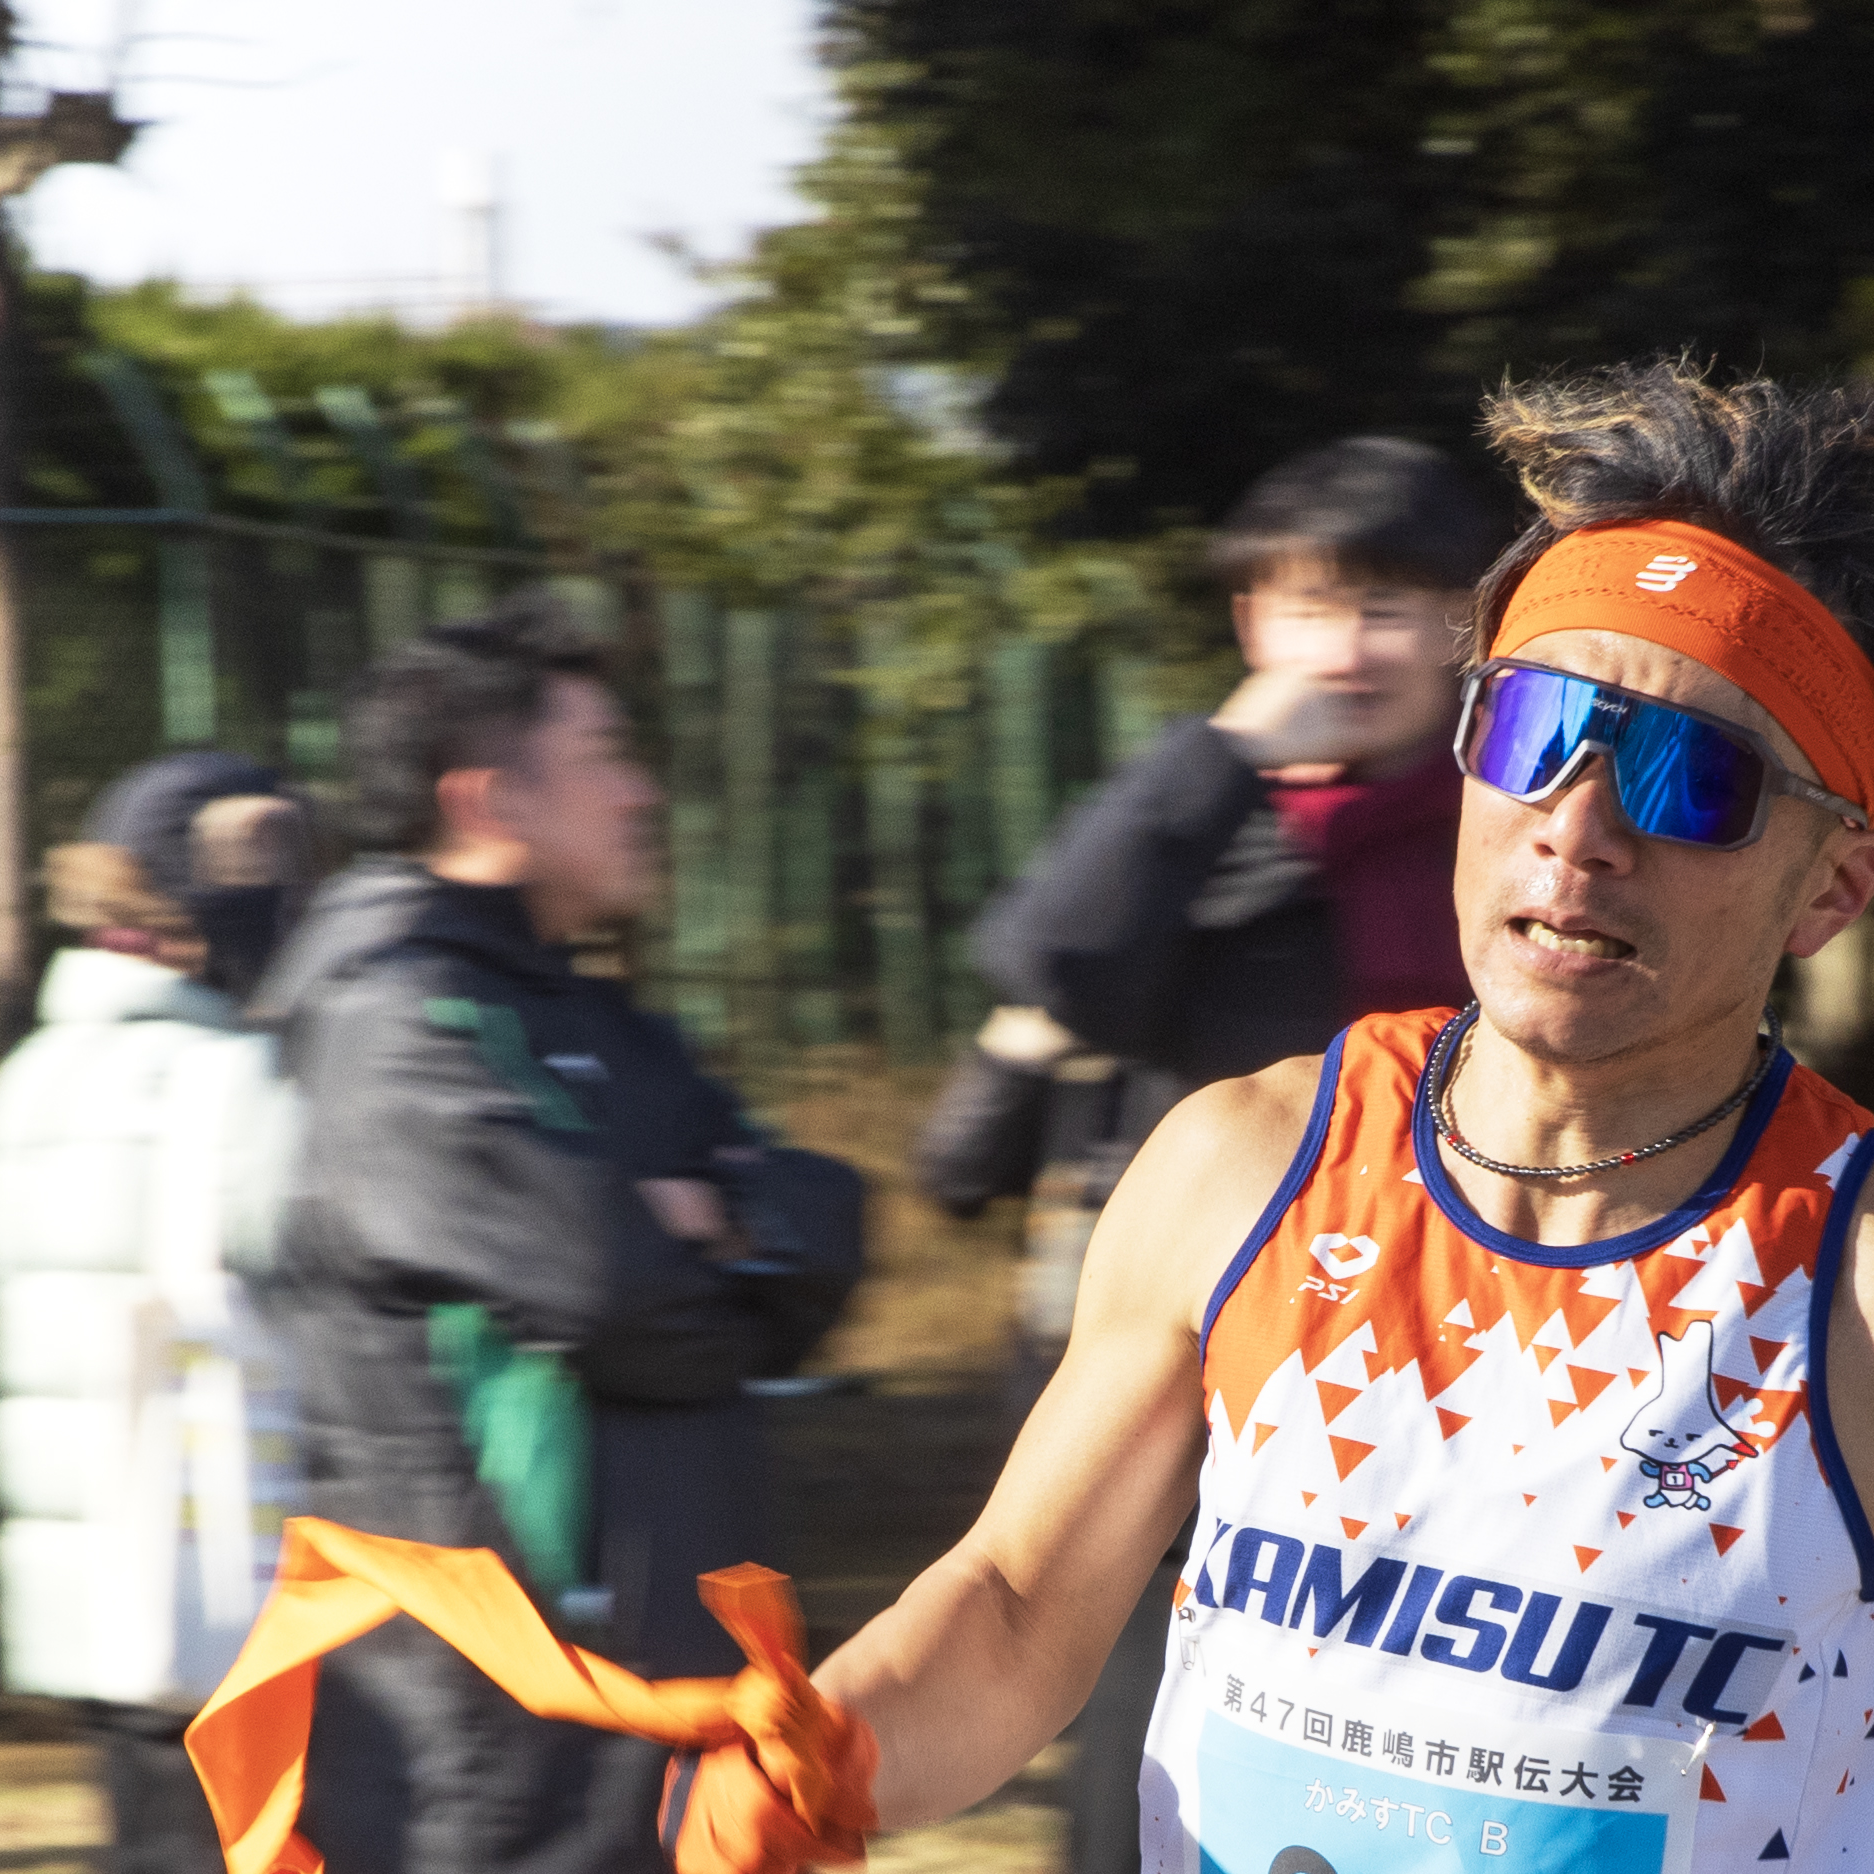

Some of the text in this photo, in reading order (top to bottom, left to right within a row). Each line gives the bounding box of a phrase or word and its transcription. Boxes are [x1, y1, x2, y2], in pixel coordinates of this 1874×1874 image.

[1623, 1612, 1786, 1725] TC
[1223, 1673, 1645, 1803] 第47回鹿嶋市駅伝大会
[1304, 1777, 1509, 1857] かみすTC B
